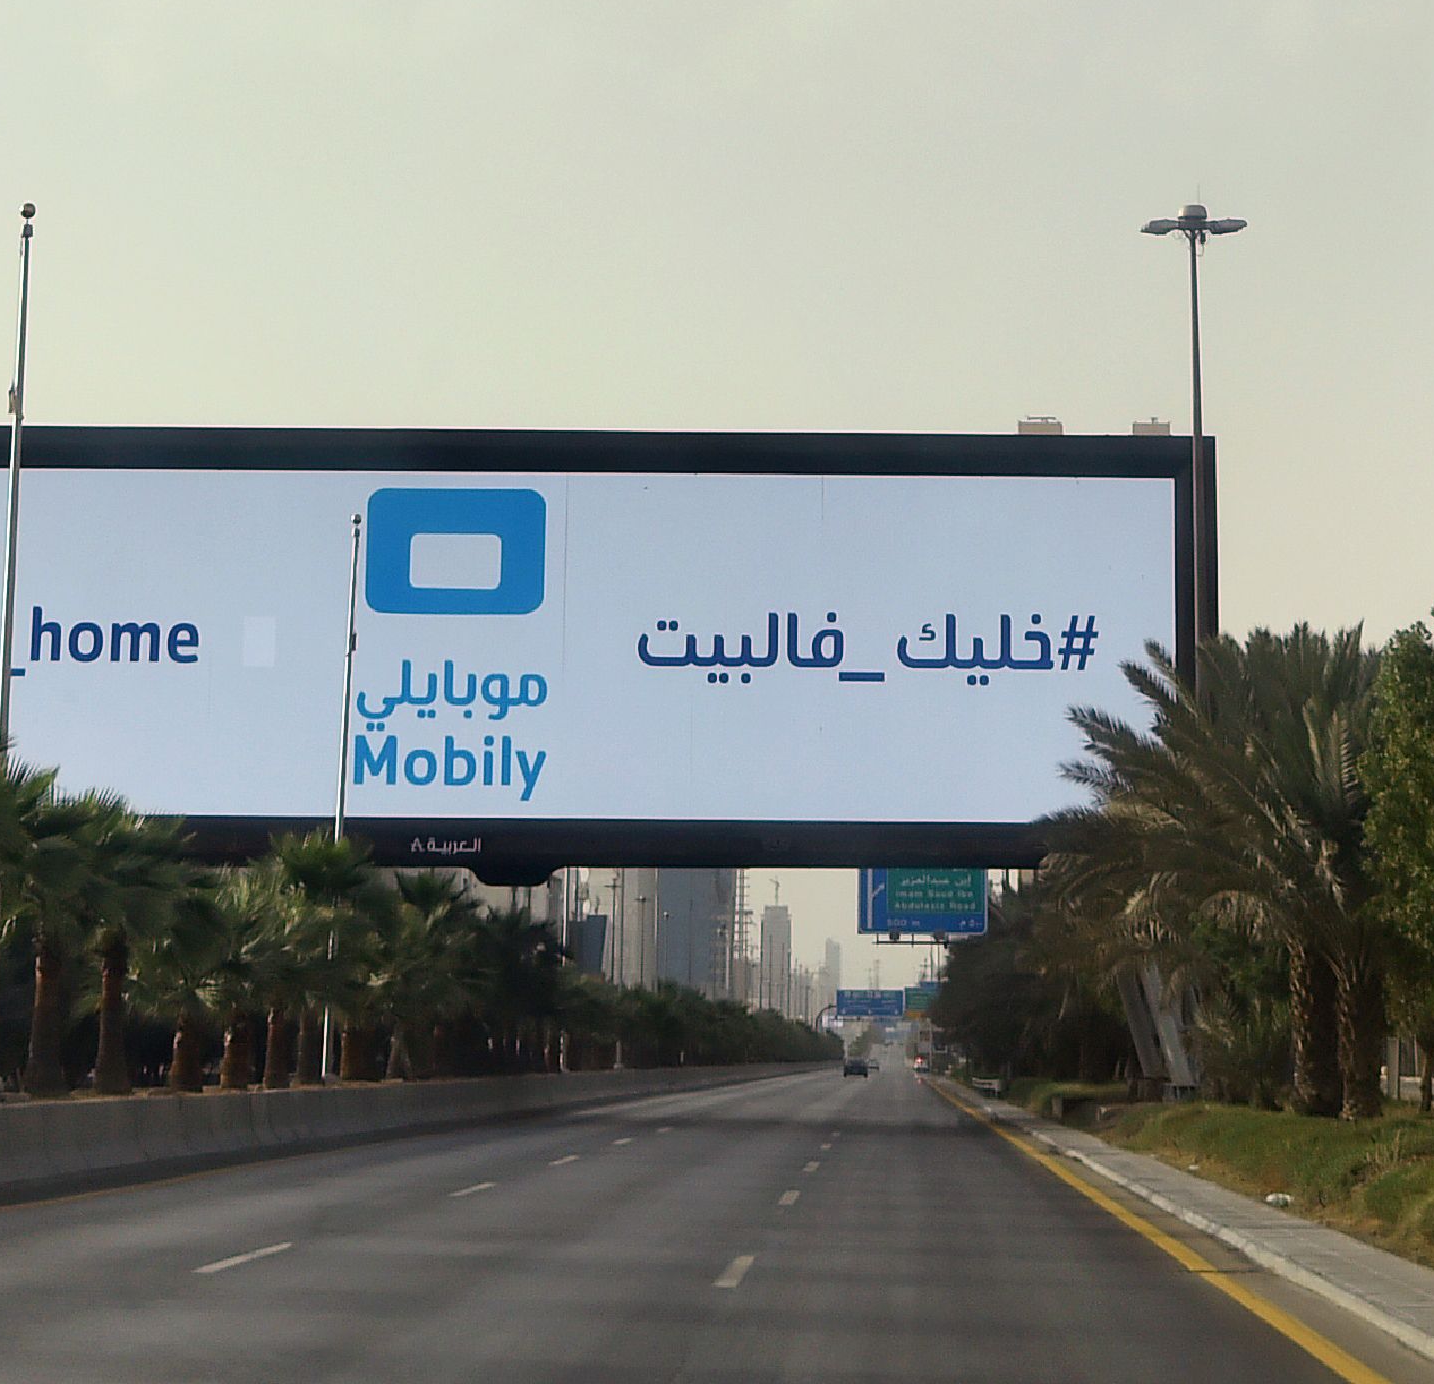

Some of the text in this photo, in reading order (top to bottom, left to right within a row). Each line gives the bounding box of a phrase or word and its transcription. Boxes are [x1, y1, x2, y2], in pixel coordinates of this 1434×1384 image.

[637, 612, 1099, 686] #خليك_فالبيت
[357, 659, 547, 732] موبايلي
[353, 734, 547, 801] Mobily
[427, 836, 481, 855] العربية
[949, 901, 976, 910] Road
